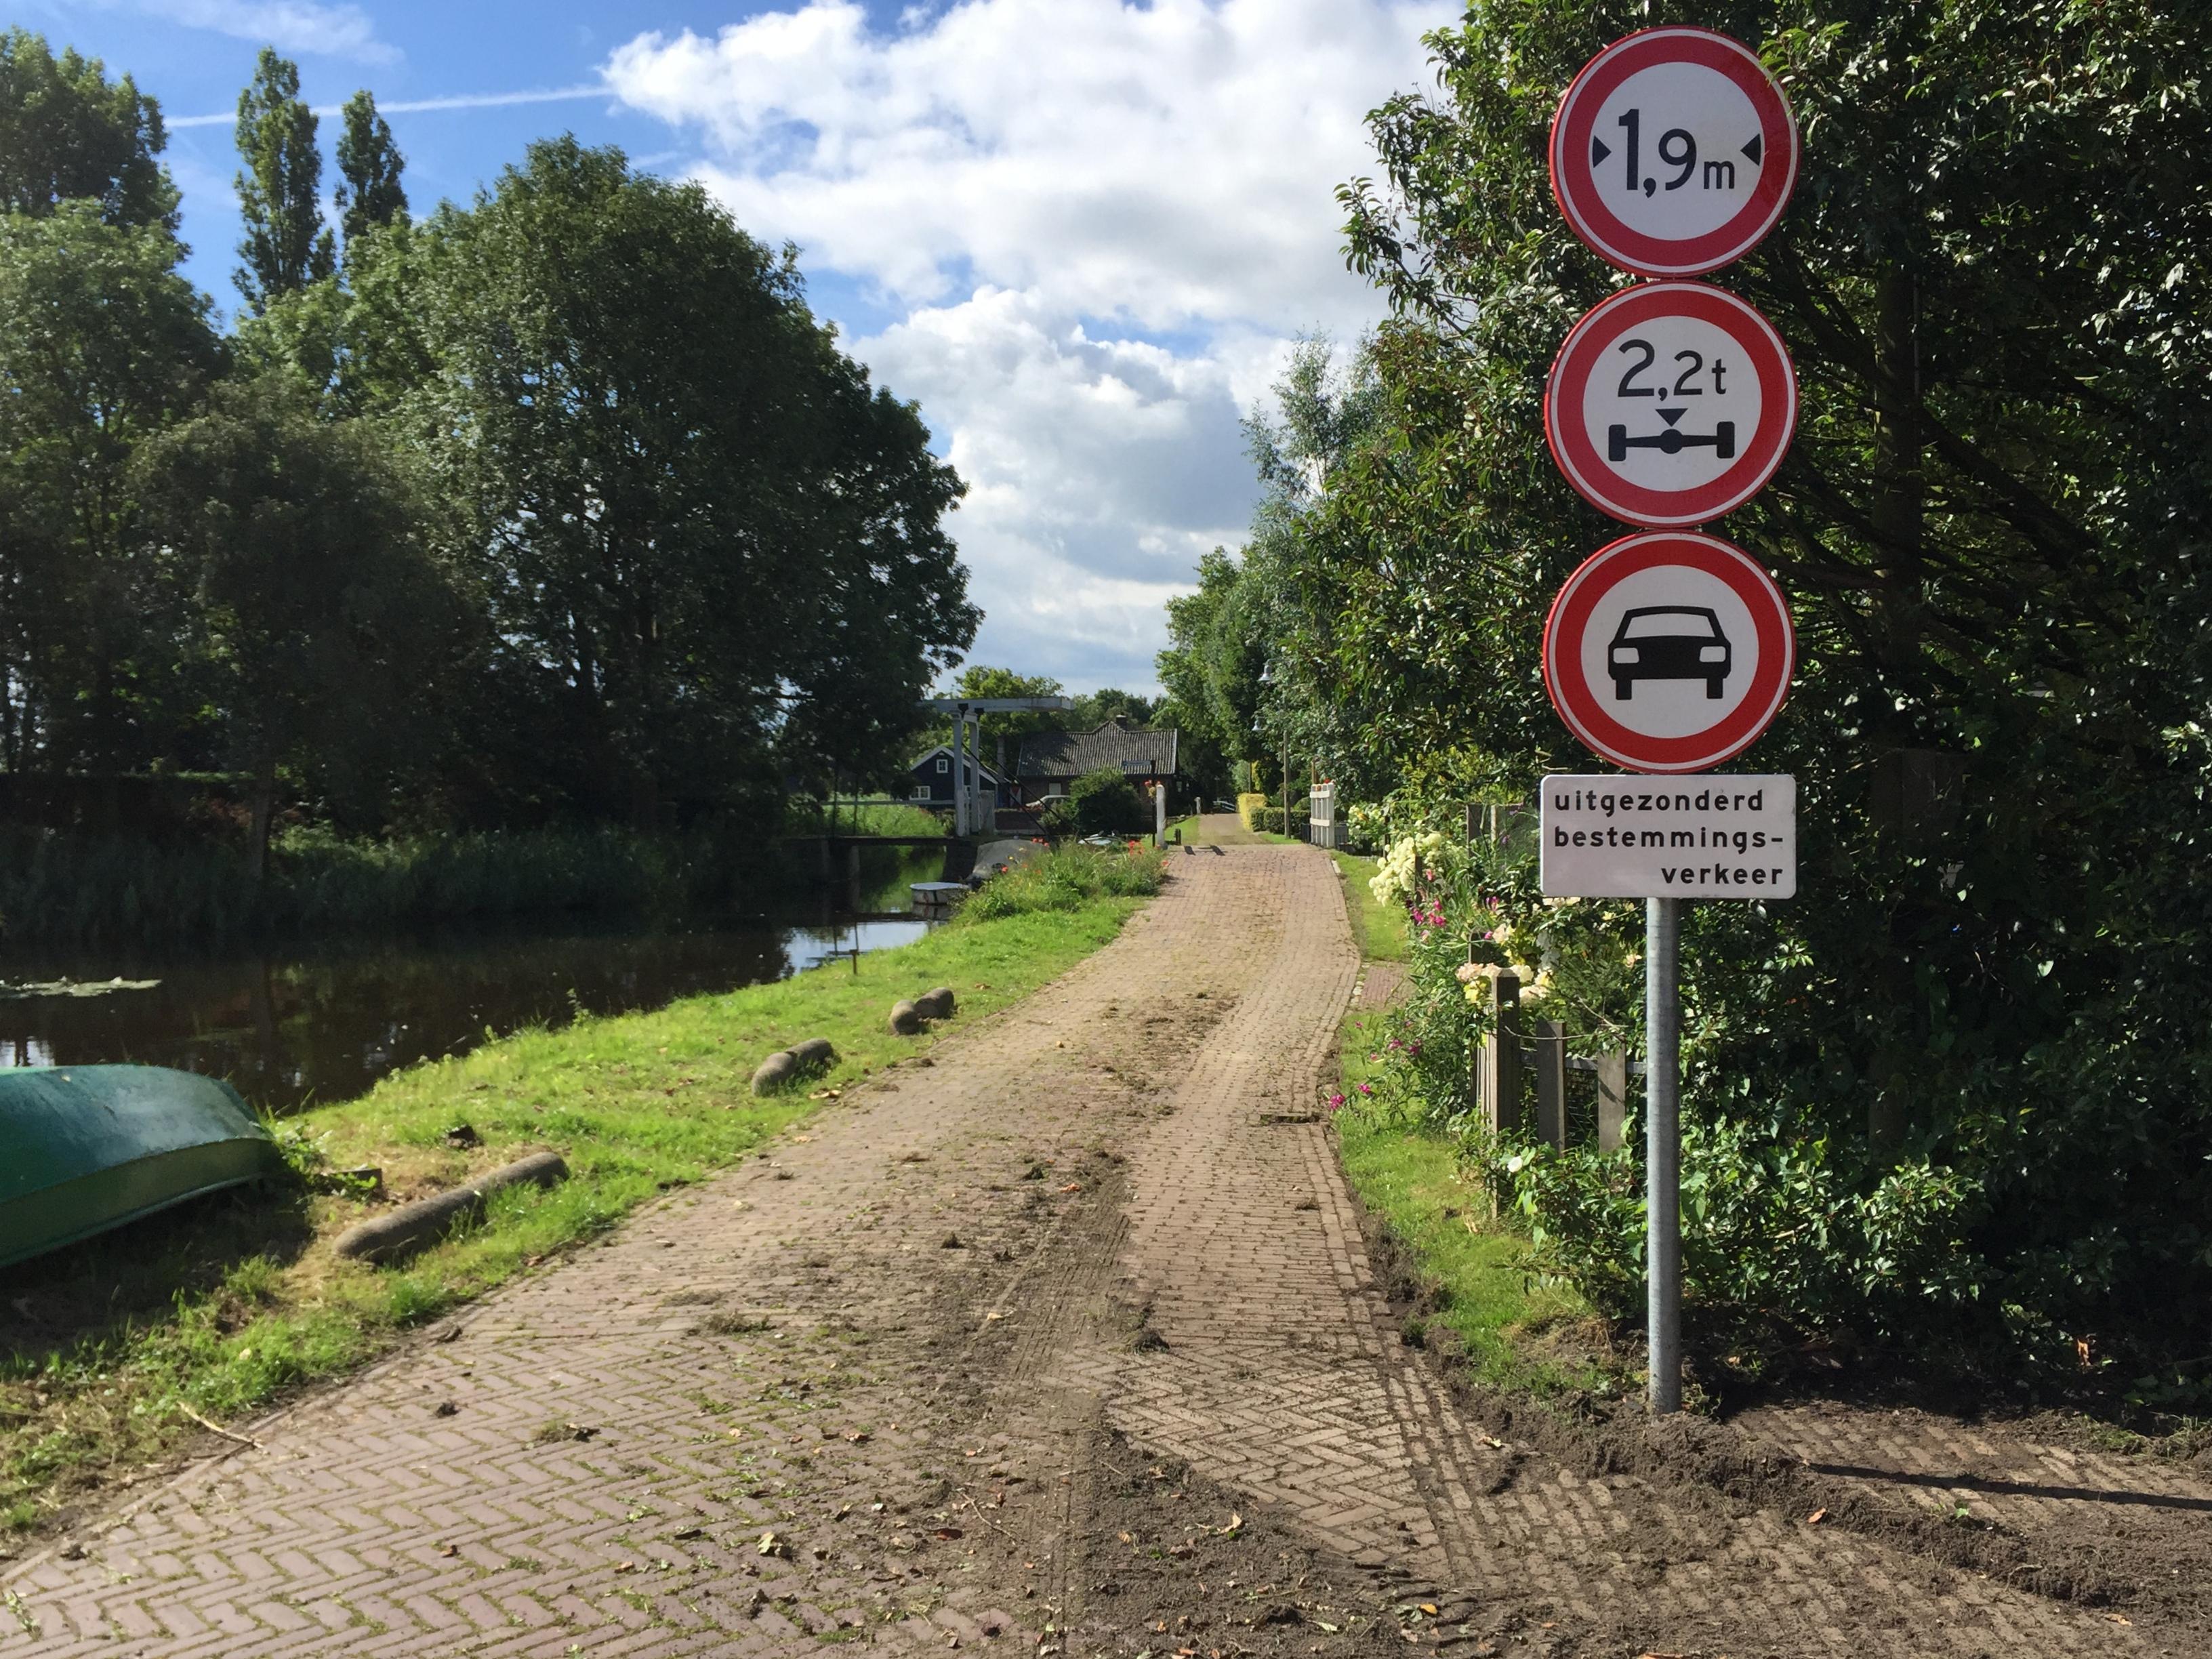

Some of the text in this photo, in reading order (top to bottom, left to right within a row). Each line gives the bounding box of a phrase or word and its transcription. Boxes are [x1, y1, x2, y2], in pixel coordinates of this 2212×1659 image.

[1555, 789, 1763, 818] uitgezonderd
[1554, 825, 1784, 855] bestemmings-
[1660, 862, 1784, 885] verkeer
